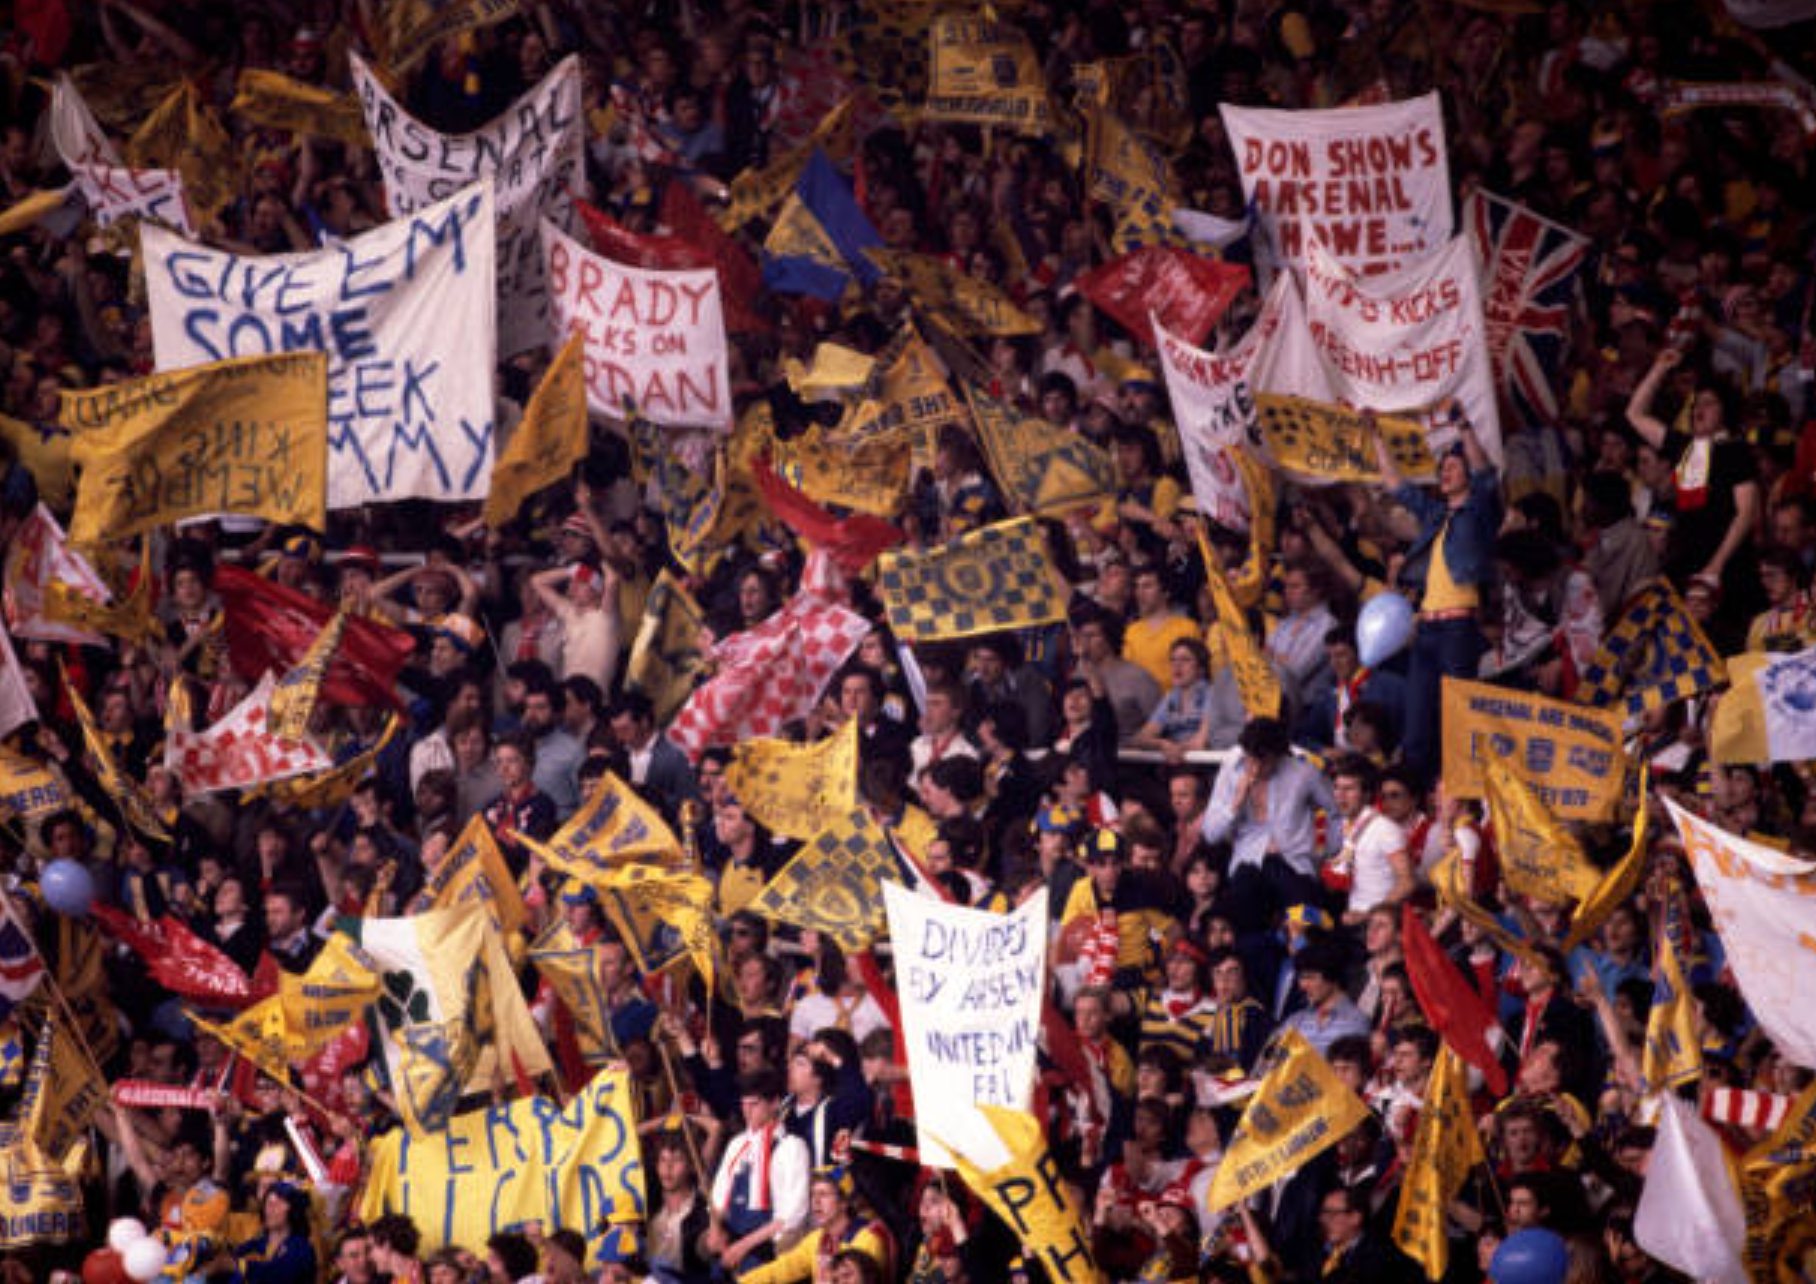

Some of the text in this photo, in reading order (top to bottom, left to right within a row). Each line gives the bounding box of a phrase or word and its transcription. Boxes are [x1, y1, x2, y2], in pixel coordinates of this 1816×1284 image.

[1243, 136, 1311, 178] DON
[1256, 174, 1412, 215] ARSENAL
[166, 250, 317, 315] GIVE
[551, 240, 714, 326] BRADY
[183, 306, 377, 362] SOME
[326, 360, 440, 425] EEK
[584, 352, 719, 413] RDAN
[326, 419, 493, 494] MMY
